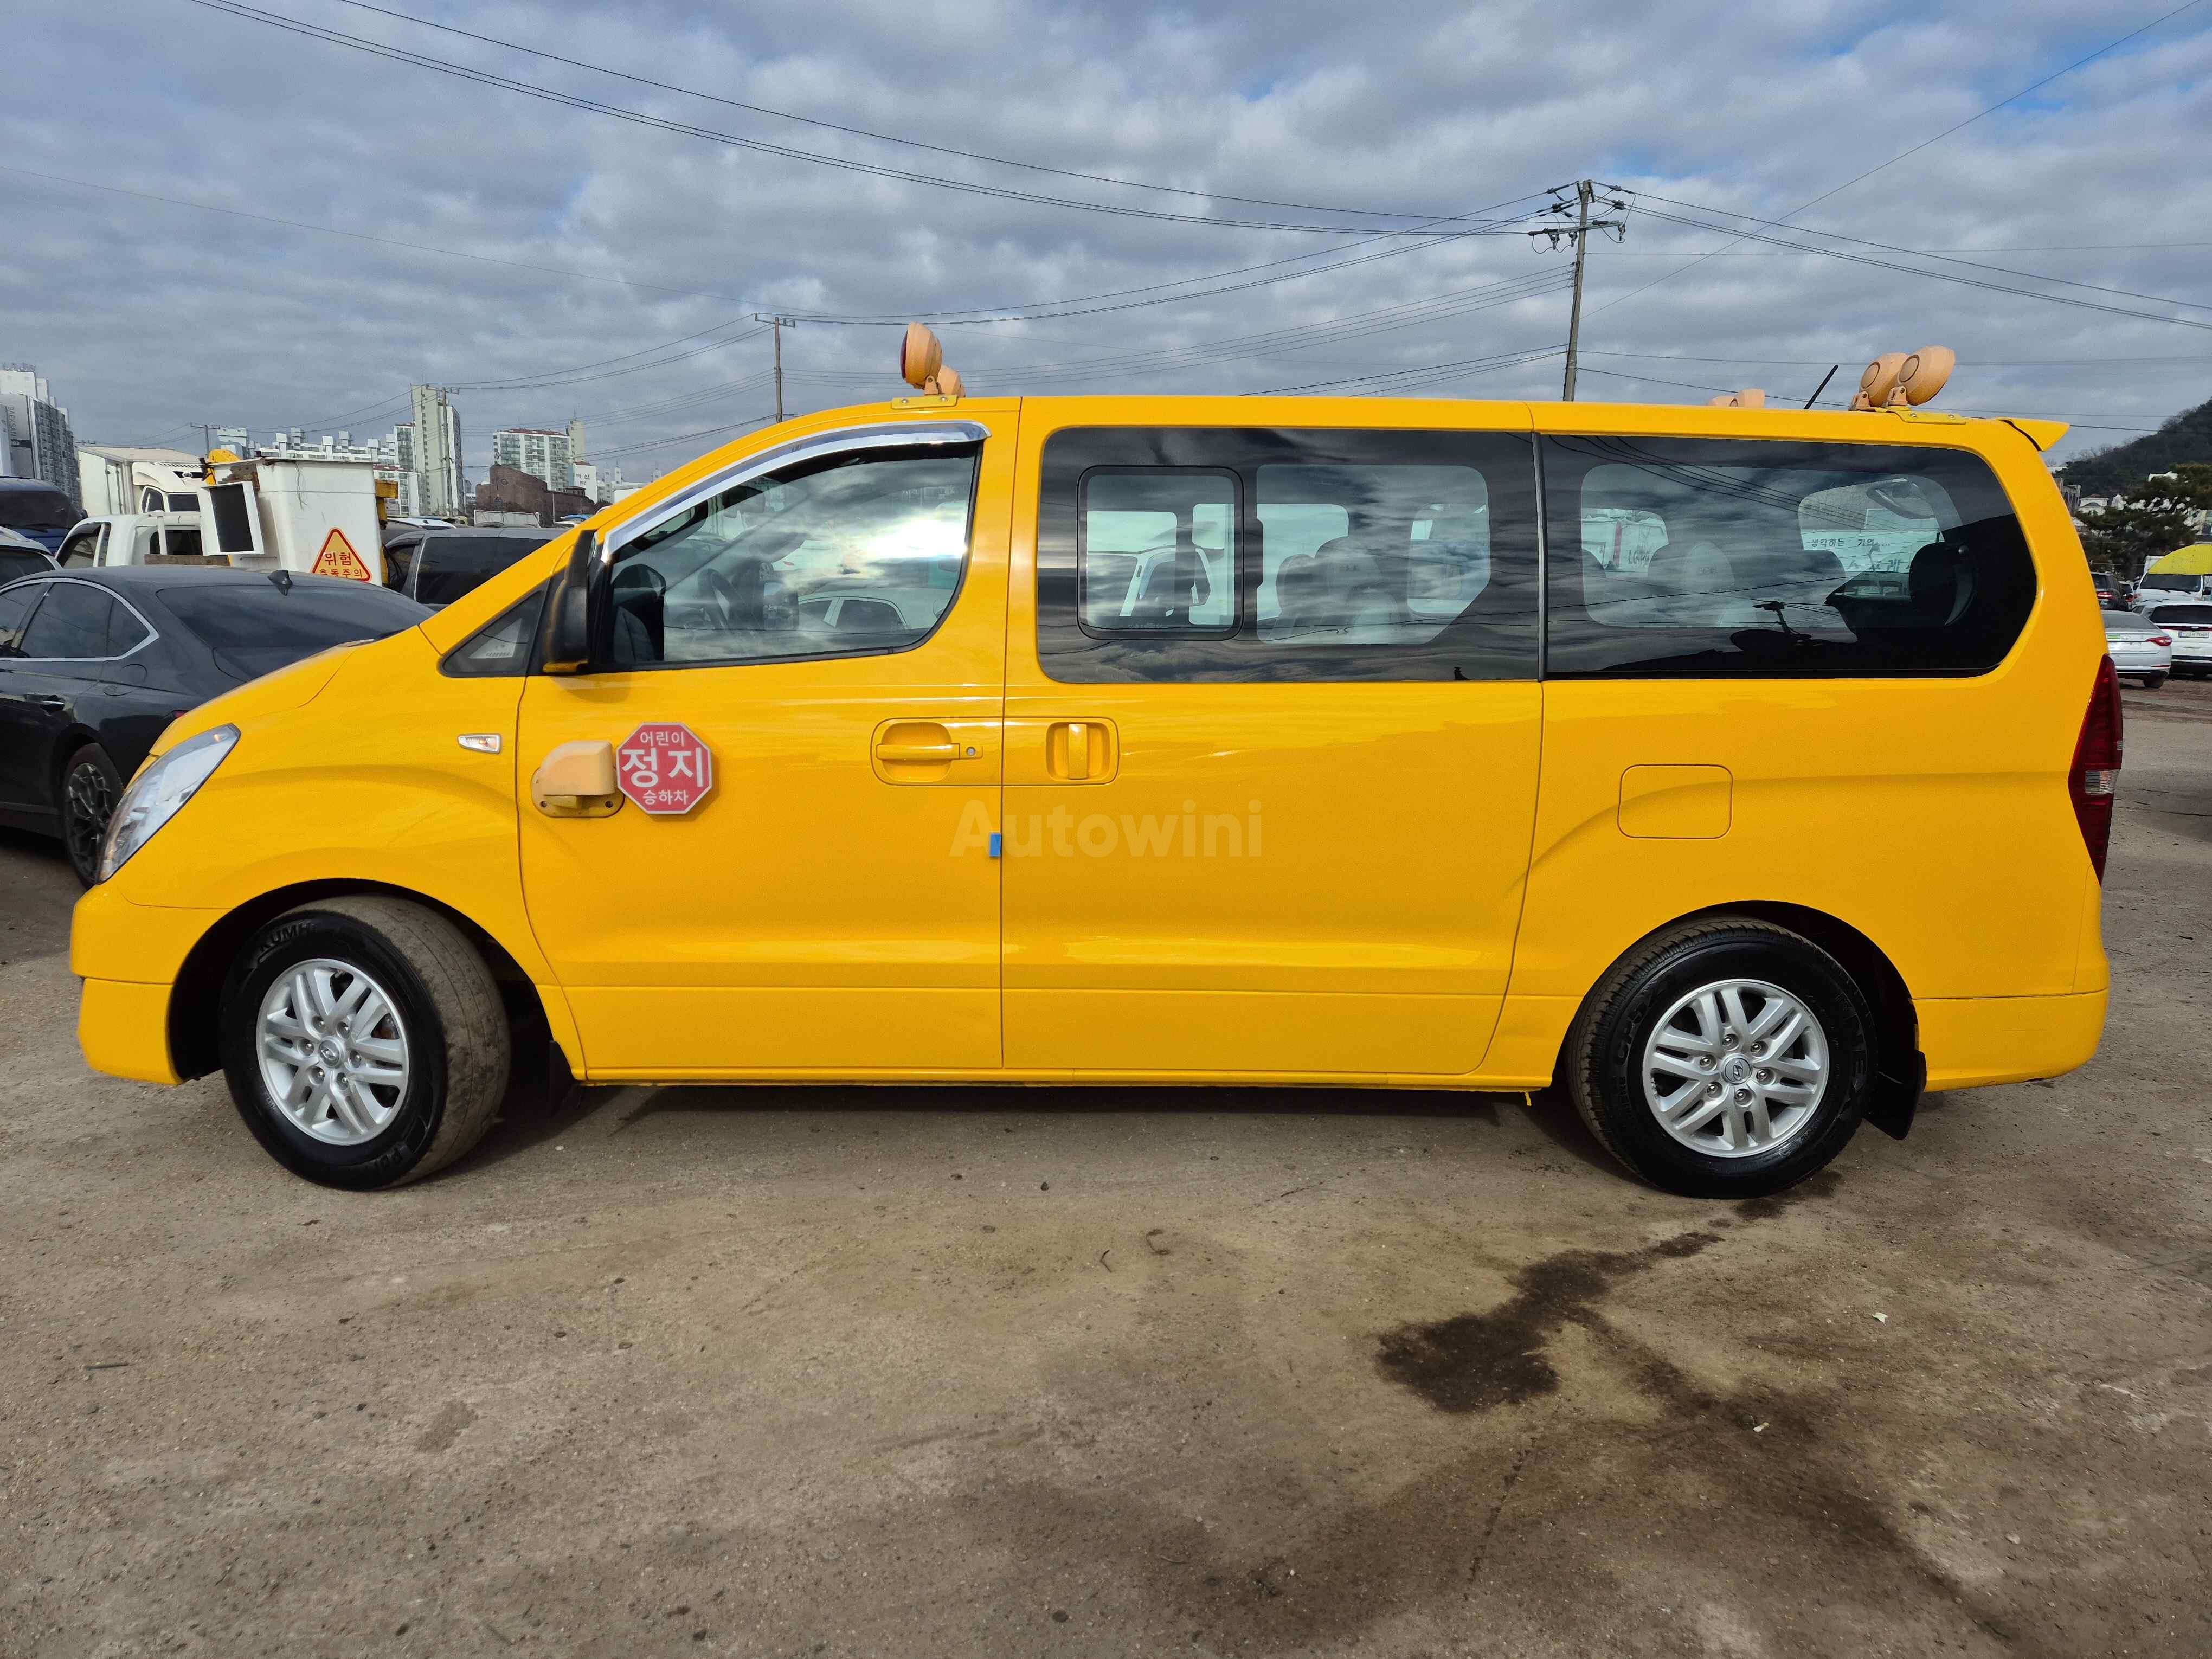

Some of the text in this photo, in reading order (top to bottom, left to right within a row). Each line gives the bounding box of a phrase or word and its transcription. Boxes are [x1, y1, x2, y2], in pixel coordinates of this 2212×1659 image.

[324, 552, 352, 566] 위험
[640, 731, 685, 747] 어린이
[621, 747, 704, 788] 정지
[642, 790, 689, 805] 승하차
